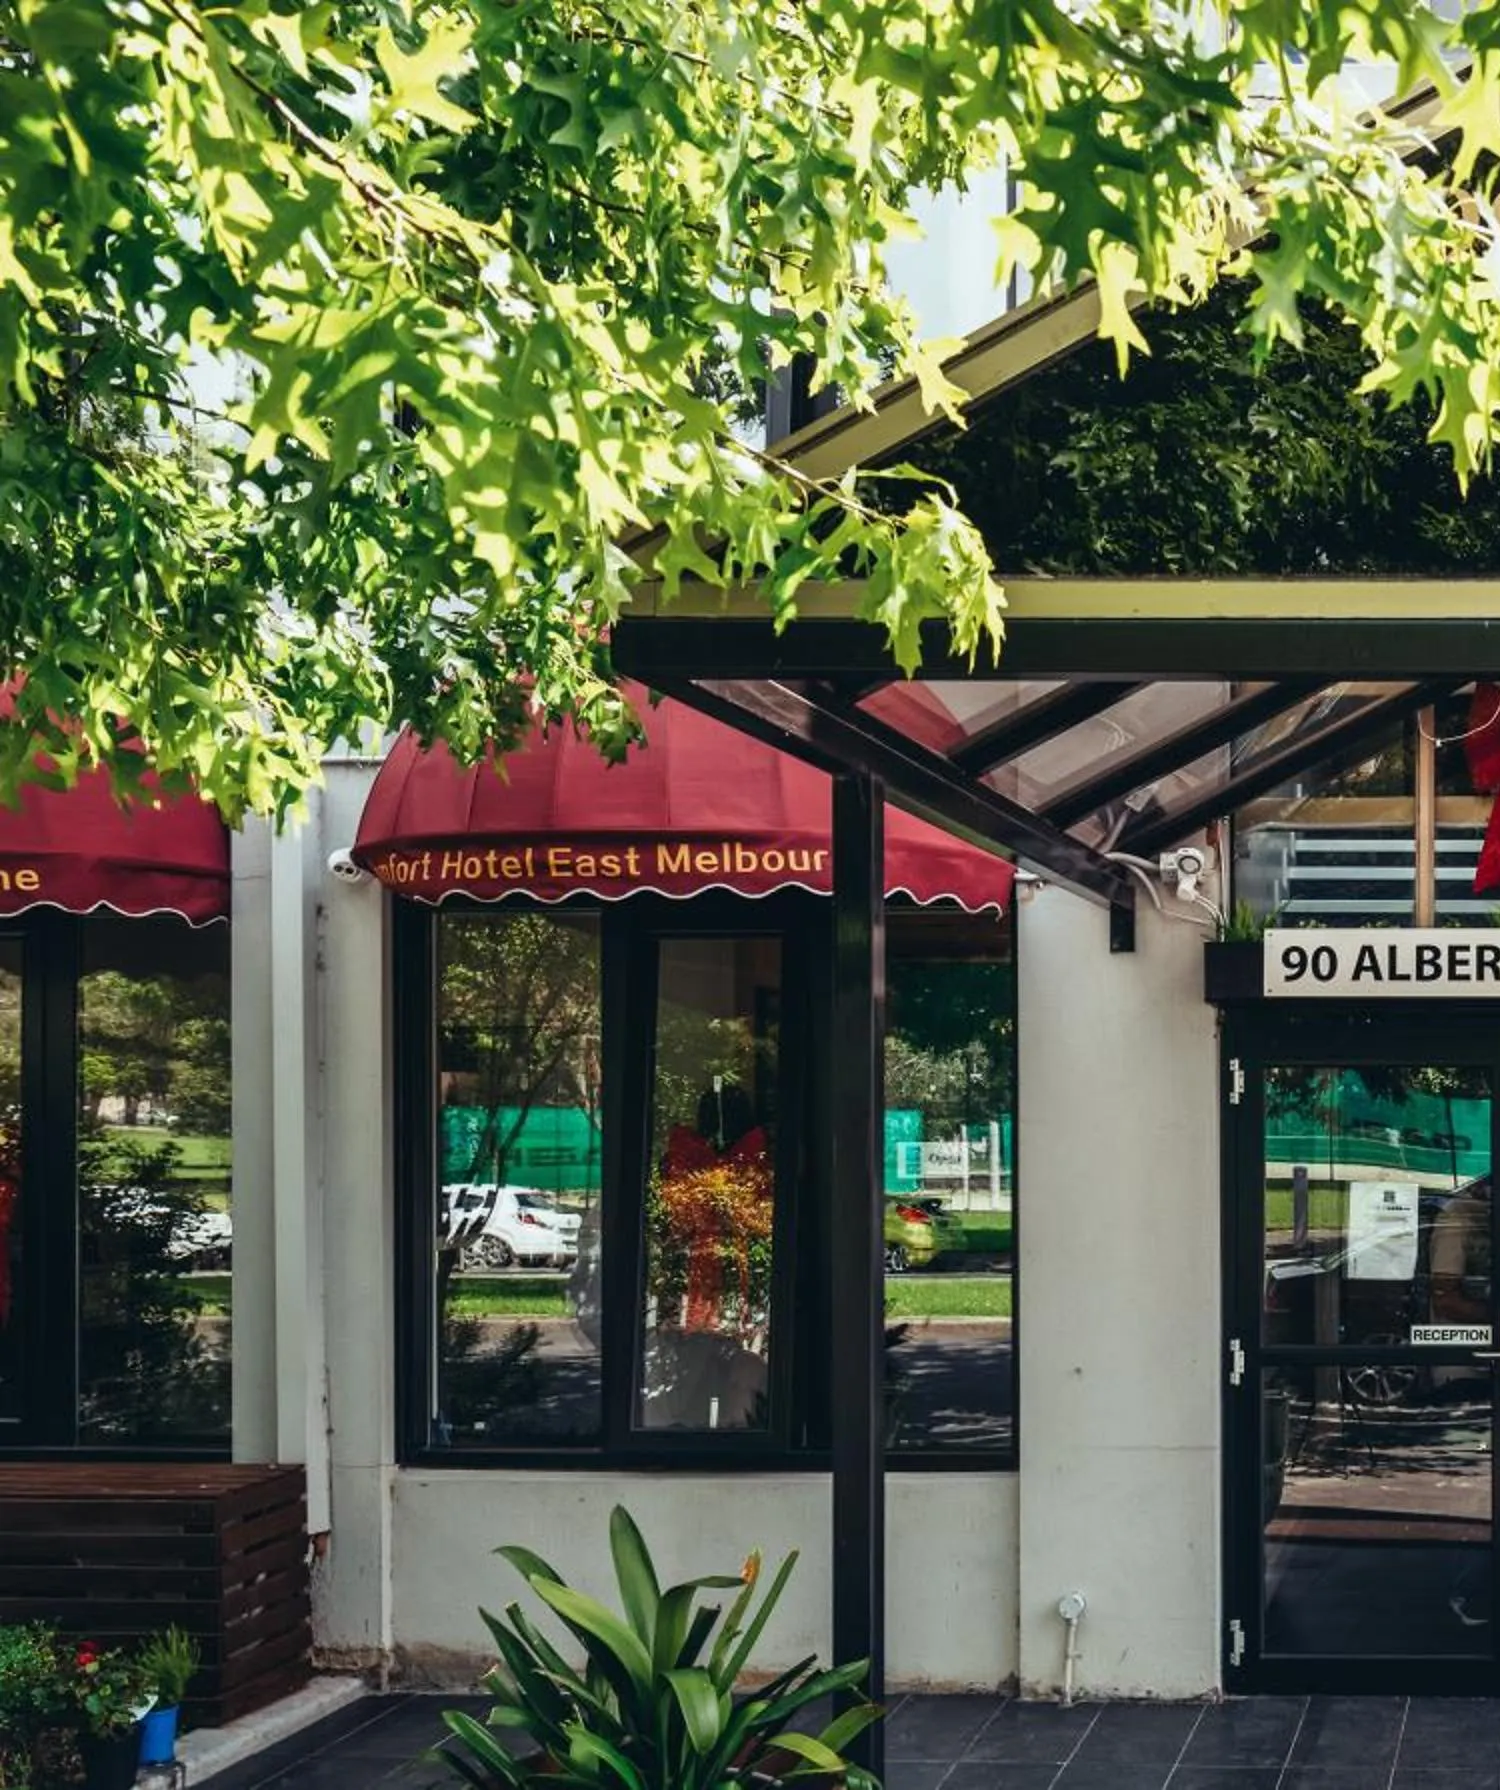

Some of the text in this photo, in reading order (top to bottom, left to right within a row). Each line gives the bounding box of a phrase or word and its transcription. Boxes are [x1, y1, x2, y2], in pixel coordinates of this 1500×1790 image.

[441, 848, 535, 879] Hotel
[549, 846, 641, 878] East
[656, 842, 829, 874] Melbour
[1281, 945, 1338, 982] 90
[1413, 1329, 1490, 1342] RECEPTION
